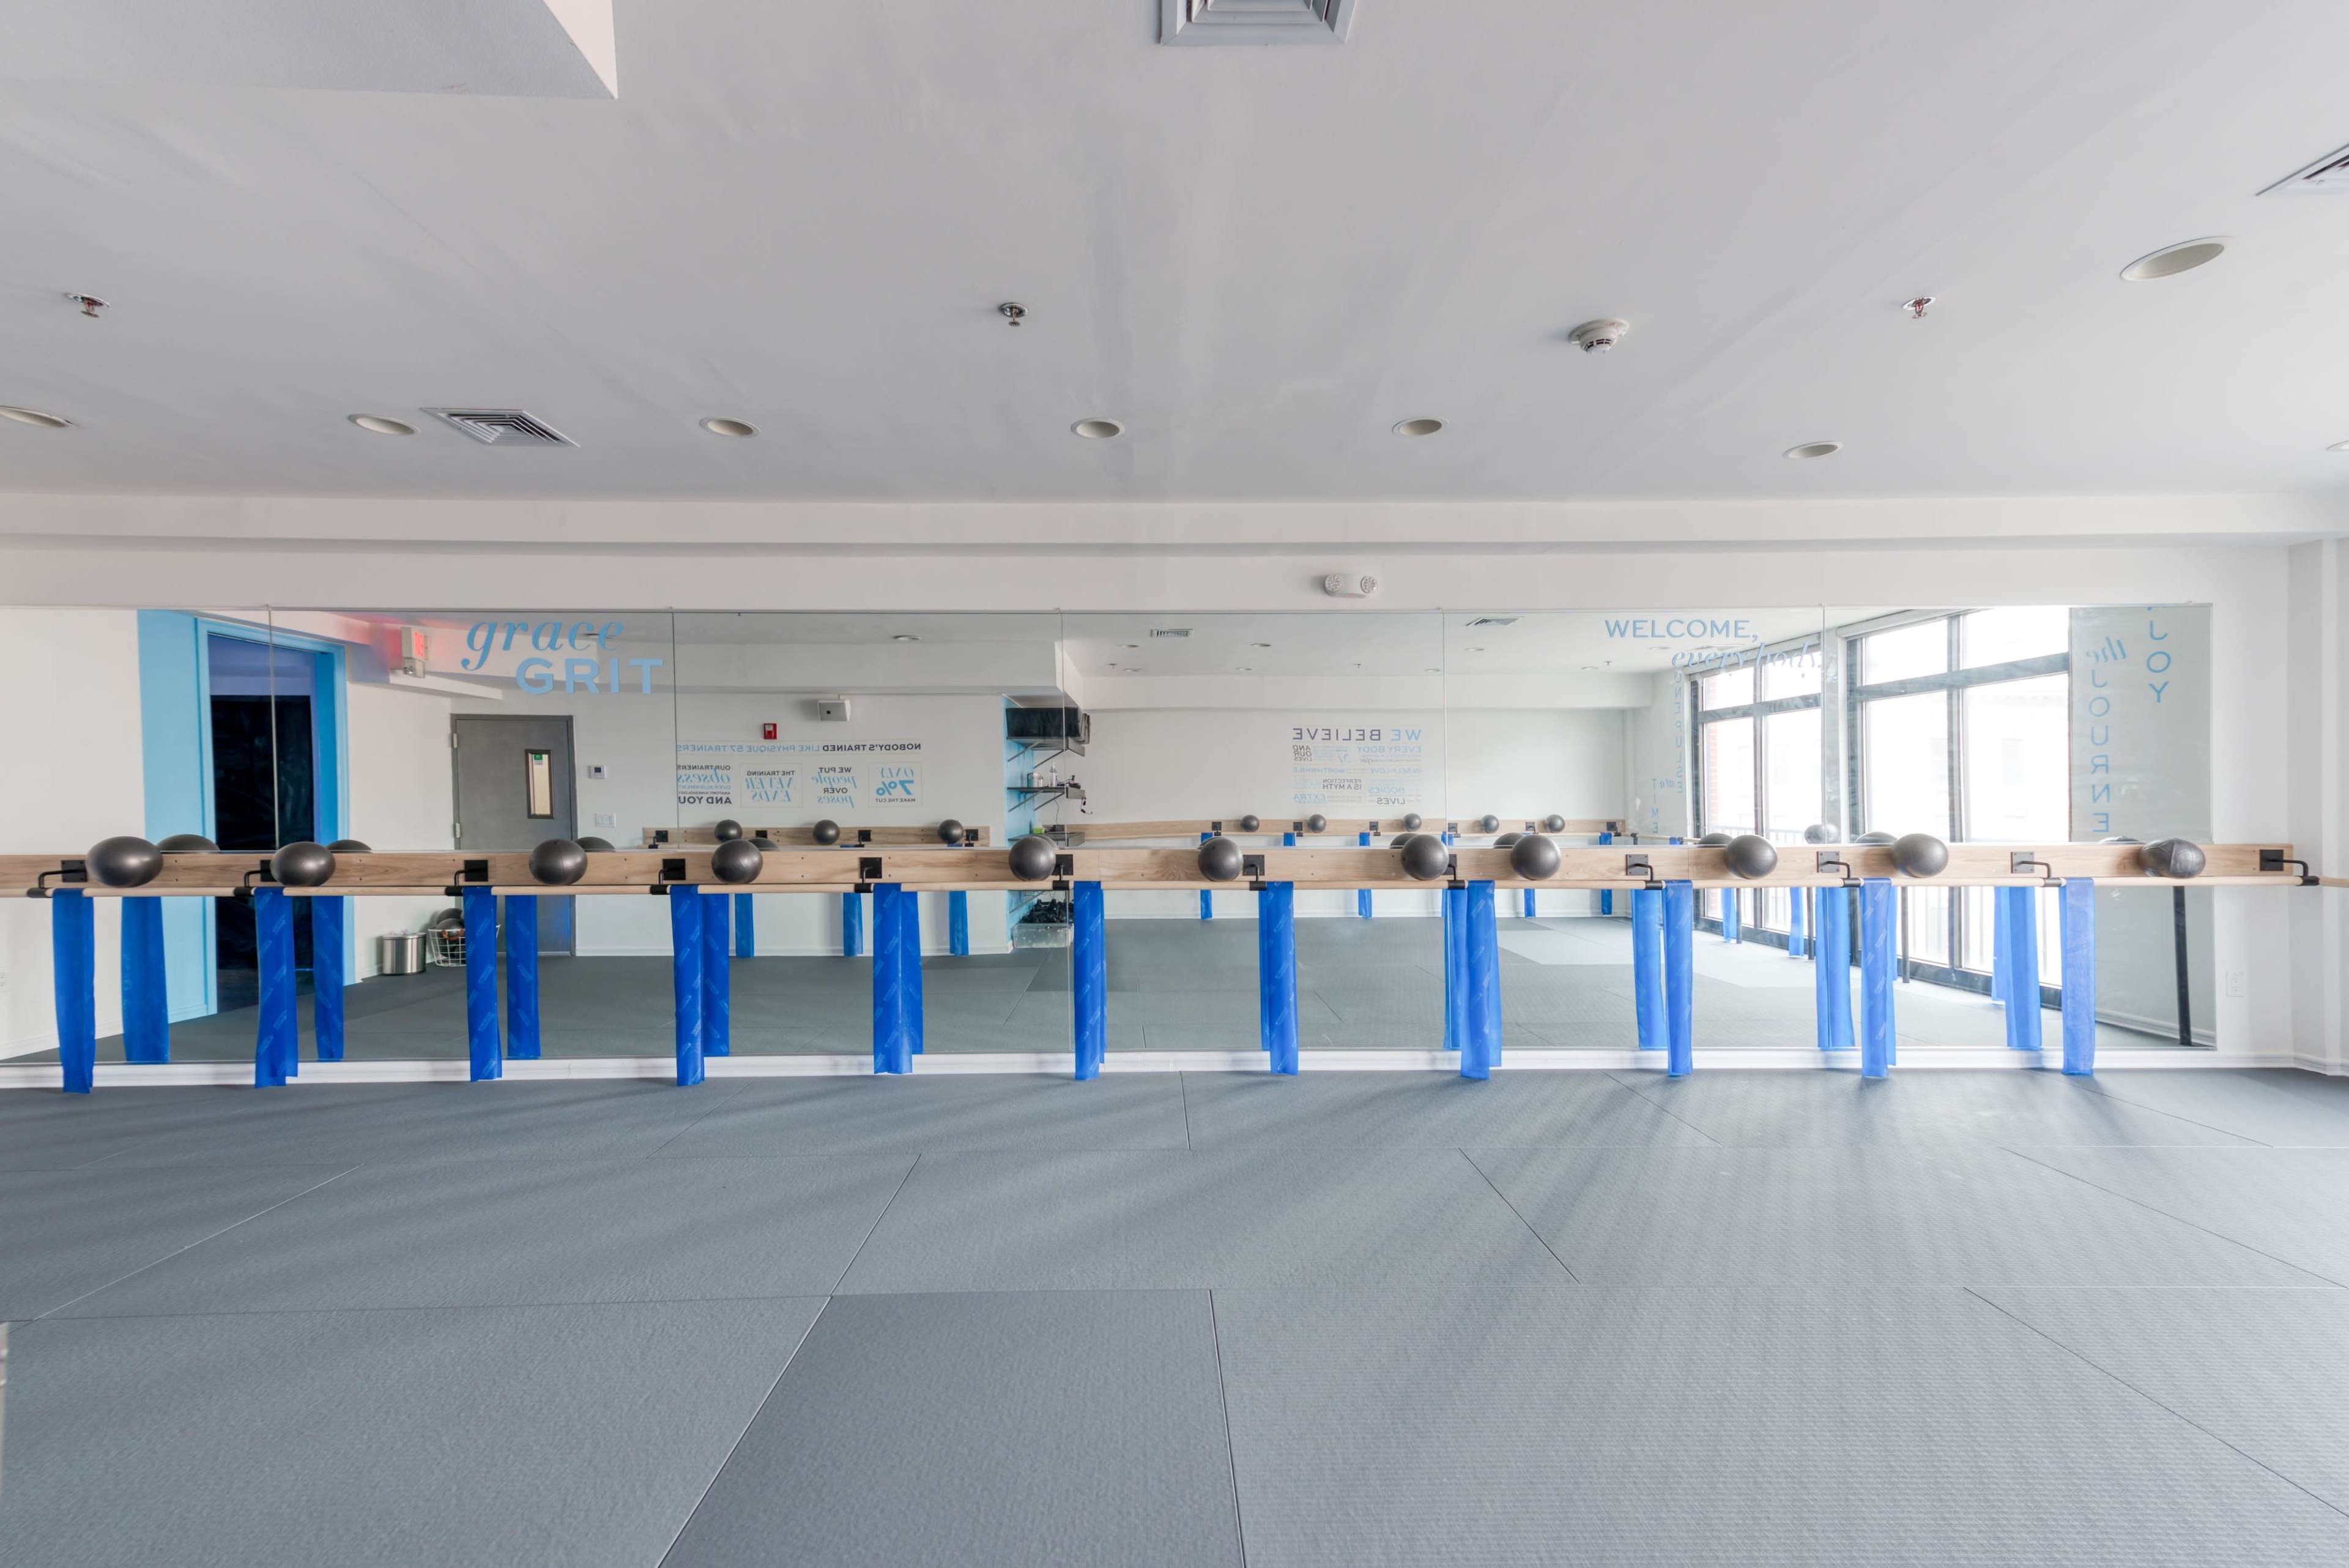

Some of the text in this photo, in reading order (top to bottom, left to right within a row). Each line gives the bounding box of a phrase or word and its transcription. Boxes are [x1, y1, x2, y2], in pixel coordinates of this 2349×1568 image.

[461, 619, 624, 671] grace
[1605, 618, 1759, 644] WELCOME,
[515, 657, 664, 696] GRIT
